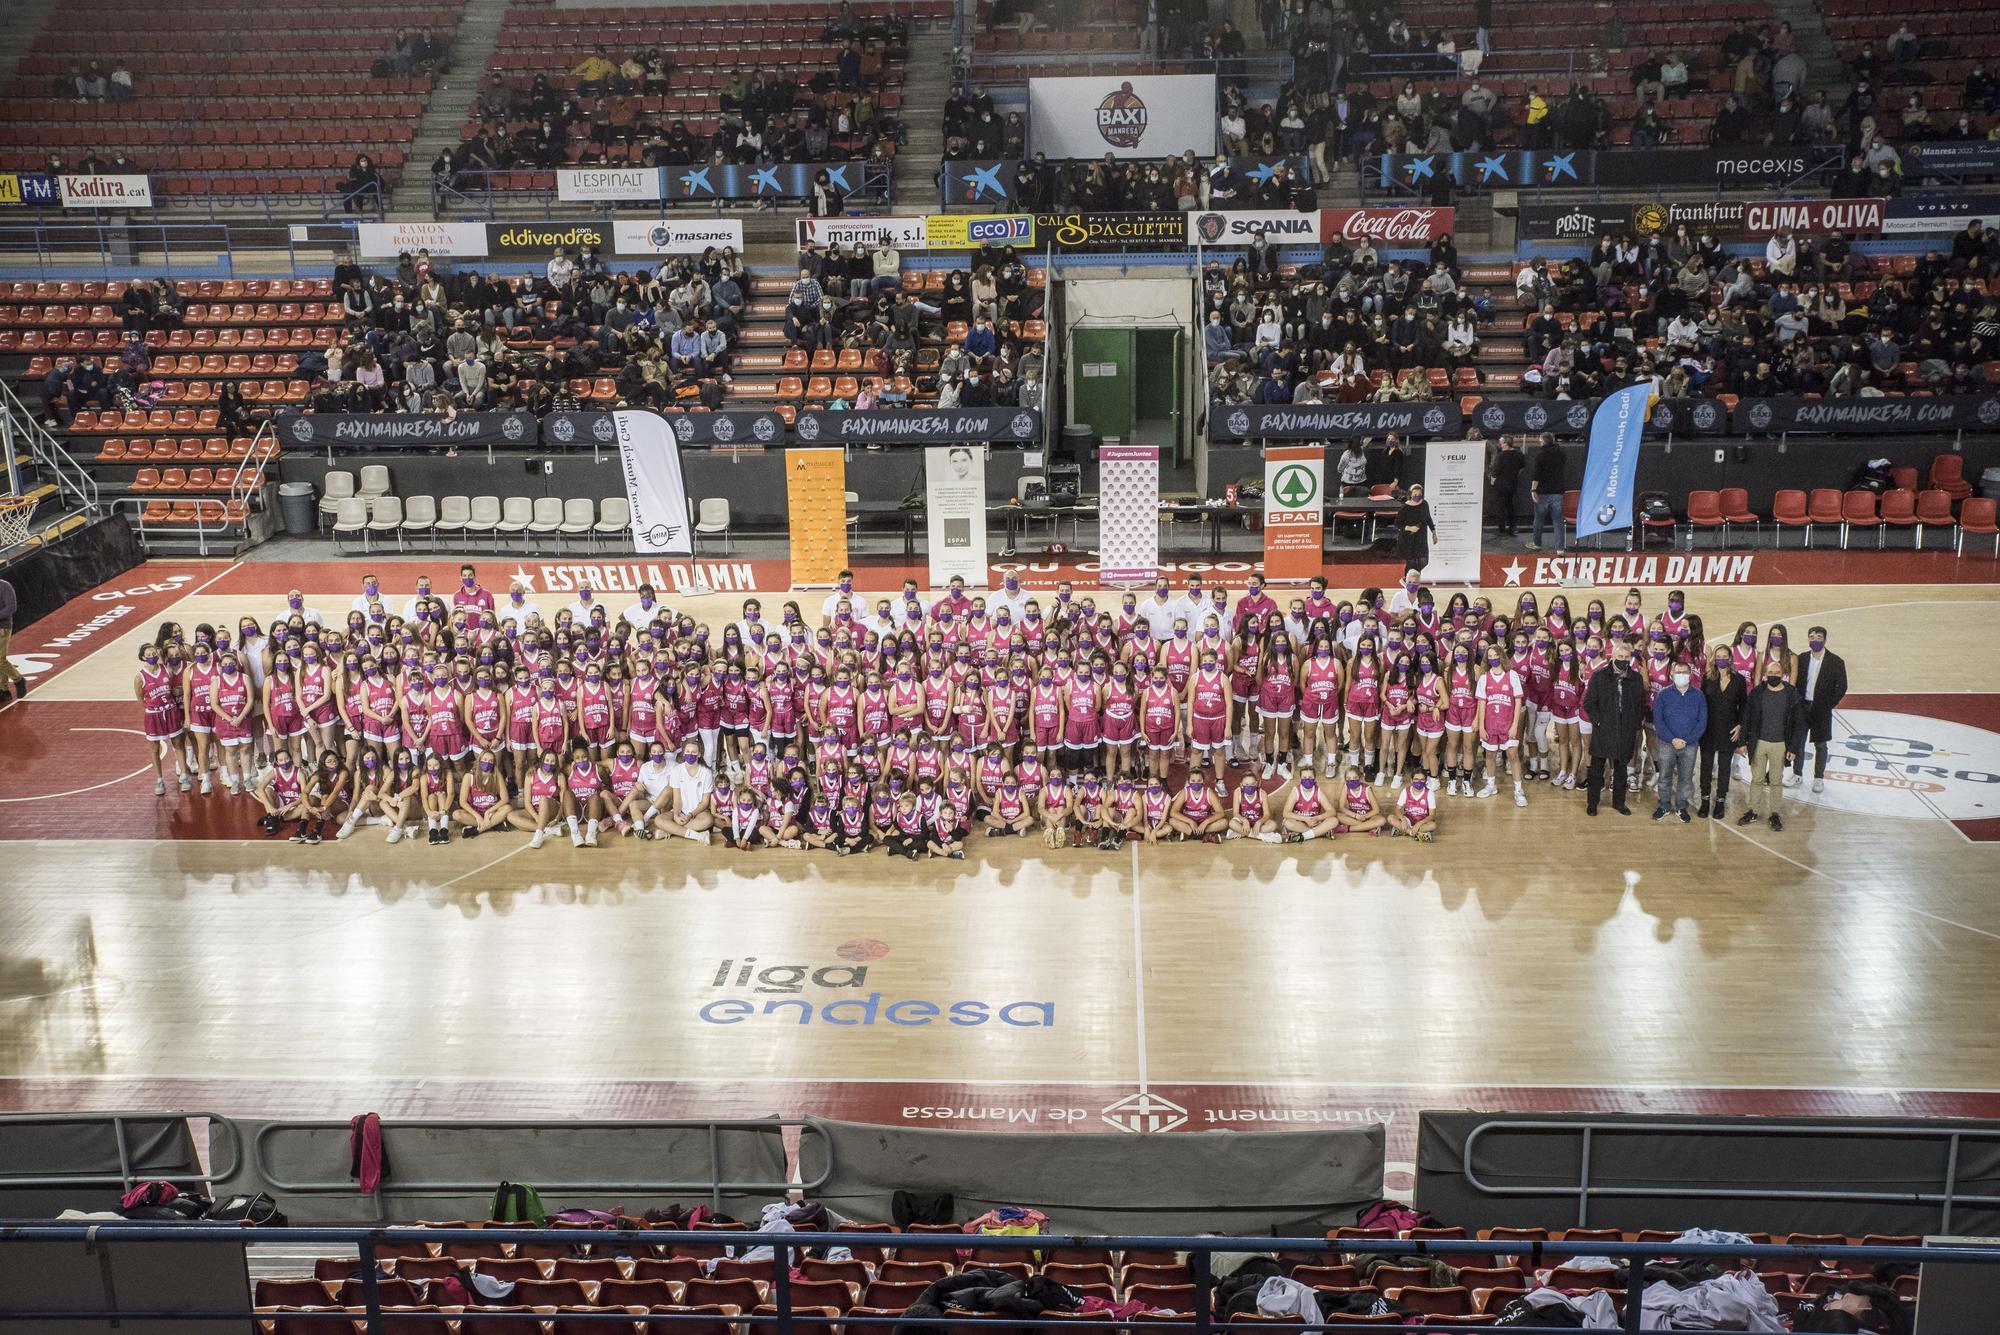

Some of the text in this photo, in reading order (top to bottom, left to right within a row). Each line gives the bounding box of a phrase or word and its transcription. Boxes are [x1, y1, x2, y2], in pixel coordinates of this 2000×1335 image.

[1099, 108, 1146, 125] BAXI
[1107, 128, 1138, 136] MANRESA
[21, 179, 52, 198] FM
[1669, 203, 1744, 224] frankfurt
[1918, 203, 1968, 211] VOLVO
[1037, 216, 1063, 226] CAL
[1342, 210, 1437, 241] Coca-Cola
[1555, 213, 1596, 236] POSTE
[1748, 206, 1810, 230] CLIMA
[1822, 204, 1880, 229] OLIVA
[1886, 221, 1916, 229] Motorcat
[1917, 221, 1948, 229] Premium
[399, 224, 445, 233] RAMON
[675, 230, 733, 241] masanés
[903, 227, 925, 241] s.l.
[1231, 219, 1313, 235] SCANIA
[393, 235, 453, 246] ROQUETA
[500, 228, 601, 246] eldivendres
[1260, 412, 1412, 431] BAXIMANRESA.COM
[1424, 416, 1445, 424] BAXI
[1525, 413, 1547, 421] BAXI
[1795, 404, 1955, 423] BAXIMANRESA.COM
[336, 420, 480, 438] BAXIMANRESA.COM
[715, 425, 735, 433] BAXI
[841, 417, 989, 435] BAXIMANRESA.COM
[1228, 419, 1249, 427] BAXI
[1270, 512, 1318, 523] SPAR
[990, 561, 1265, 572] OU CNGOS
[1533, 555, 1754, 585] ESTRELLA DAMM
[540, 563, 757, 592] ESTRELLA DAMM
[1830, 771, 1932, 792] GROUP
[712, 956, 869, 994] liga
[700, 992, 1055, 1027] endesa
[902, 1106, 1395, 1126] Ajuntament de Manresa
